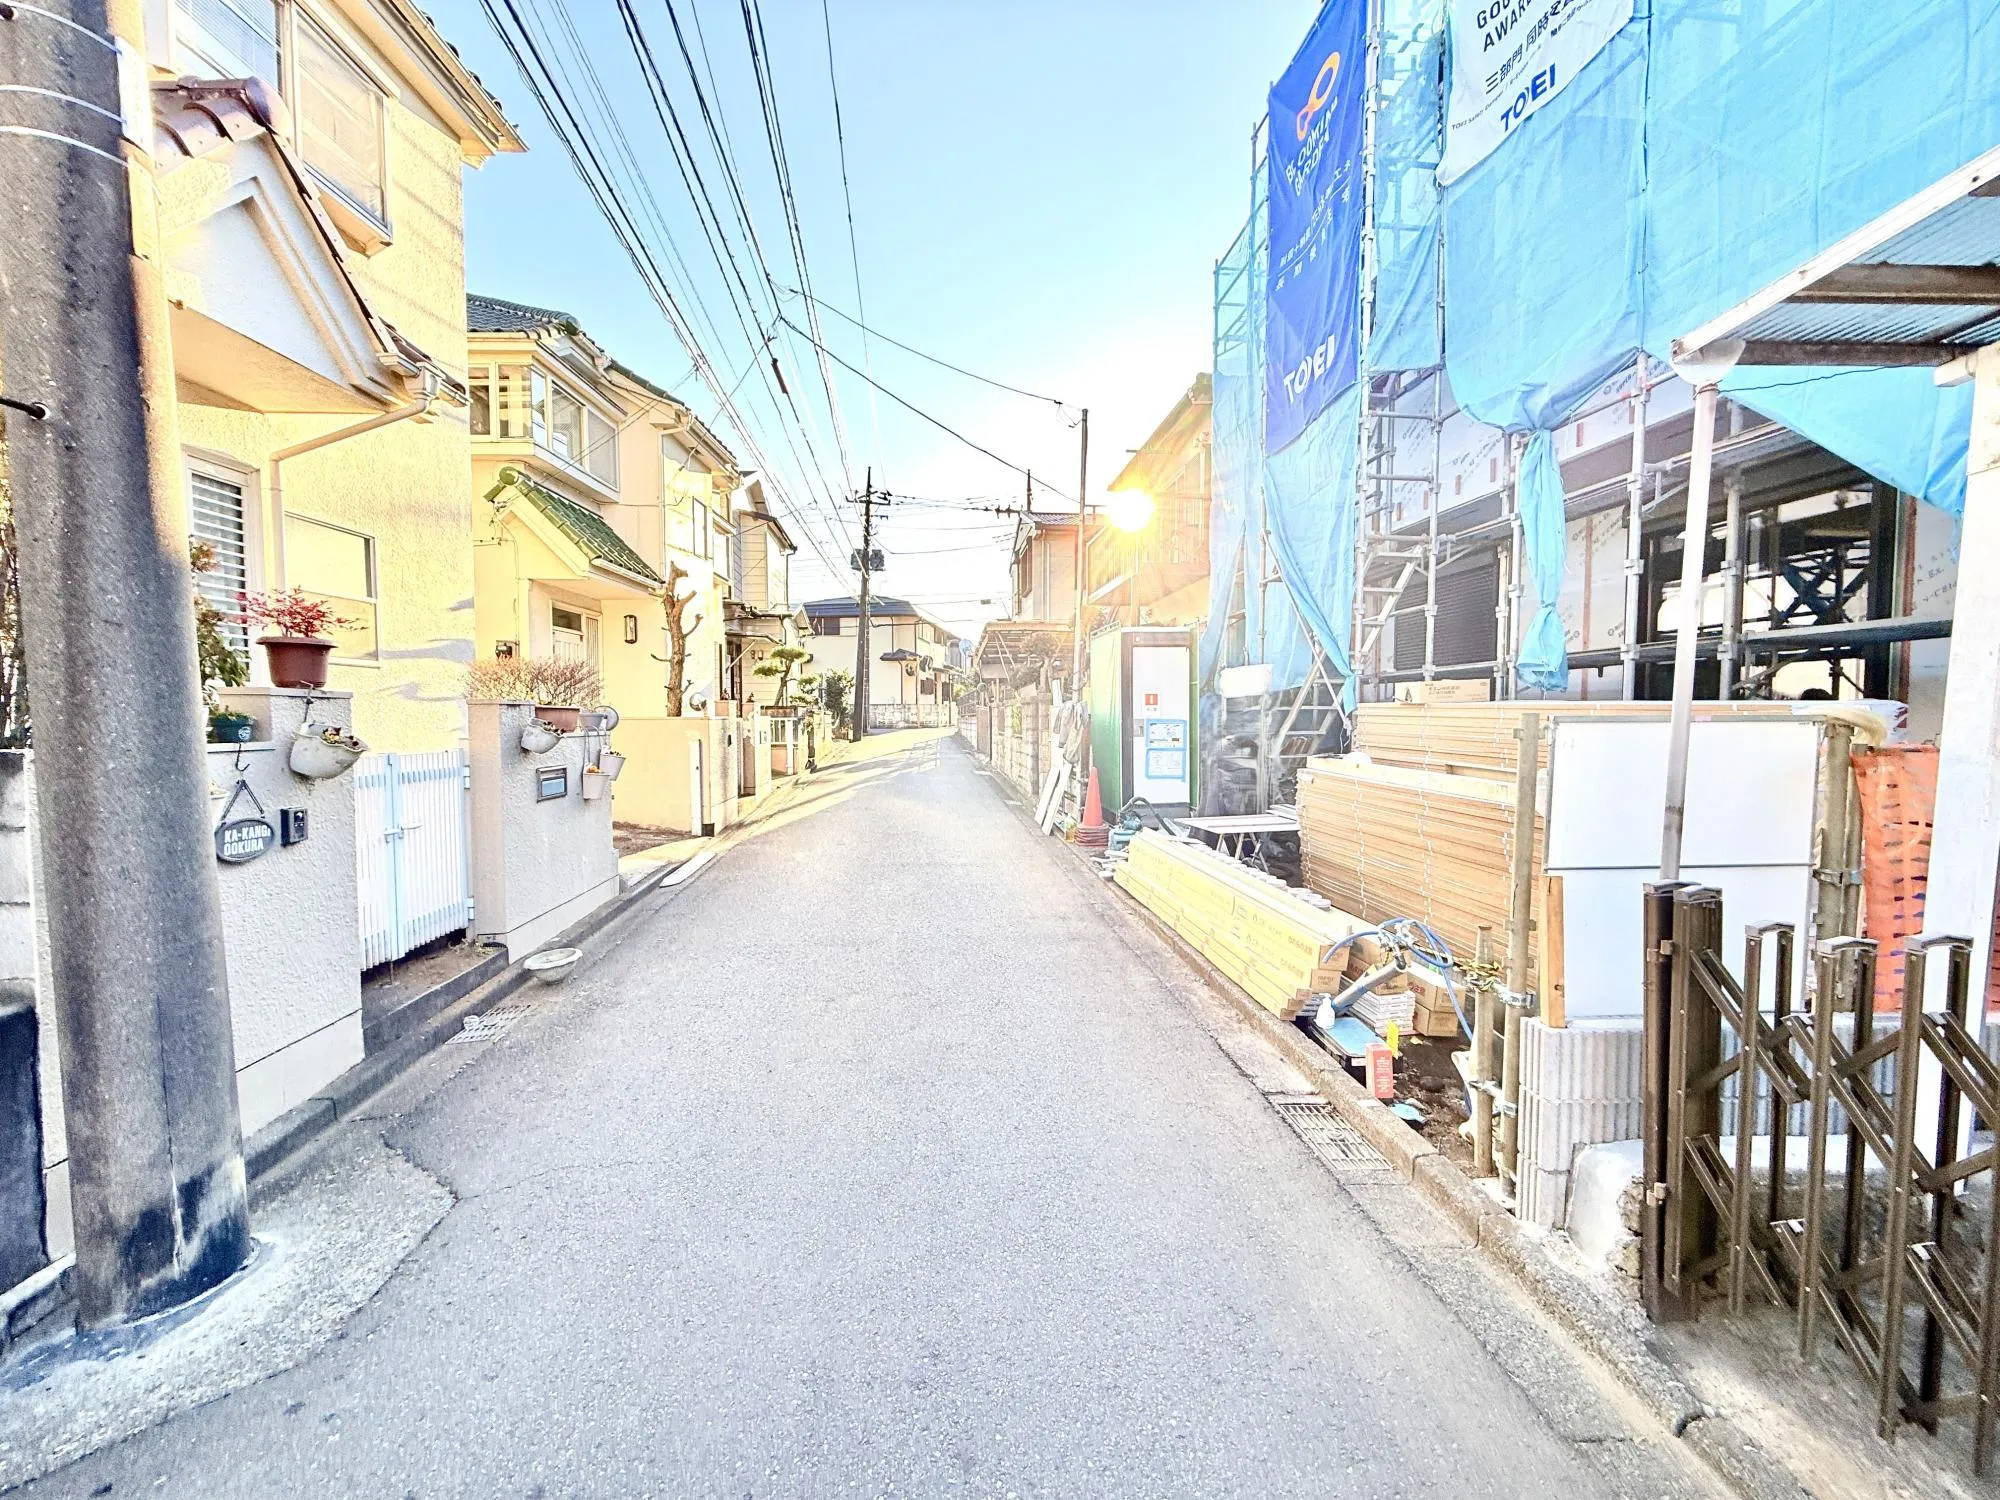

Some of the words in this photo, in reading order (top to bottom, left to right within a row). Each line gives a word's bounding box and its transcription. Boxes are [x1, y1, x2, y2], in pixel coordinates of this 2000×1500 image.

[1485, 43, 1523, 95] 三部門
[1500, 62, 1555, 132] TOEI
[1283, 333, 1335, 404] TOEI
[223, 837, 264, 856] OOKURA
